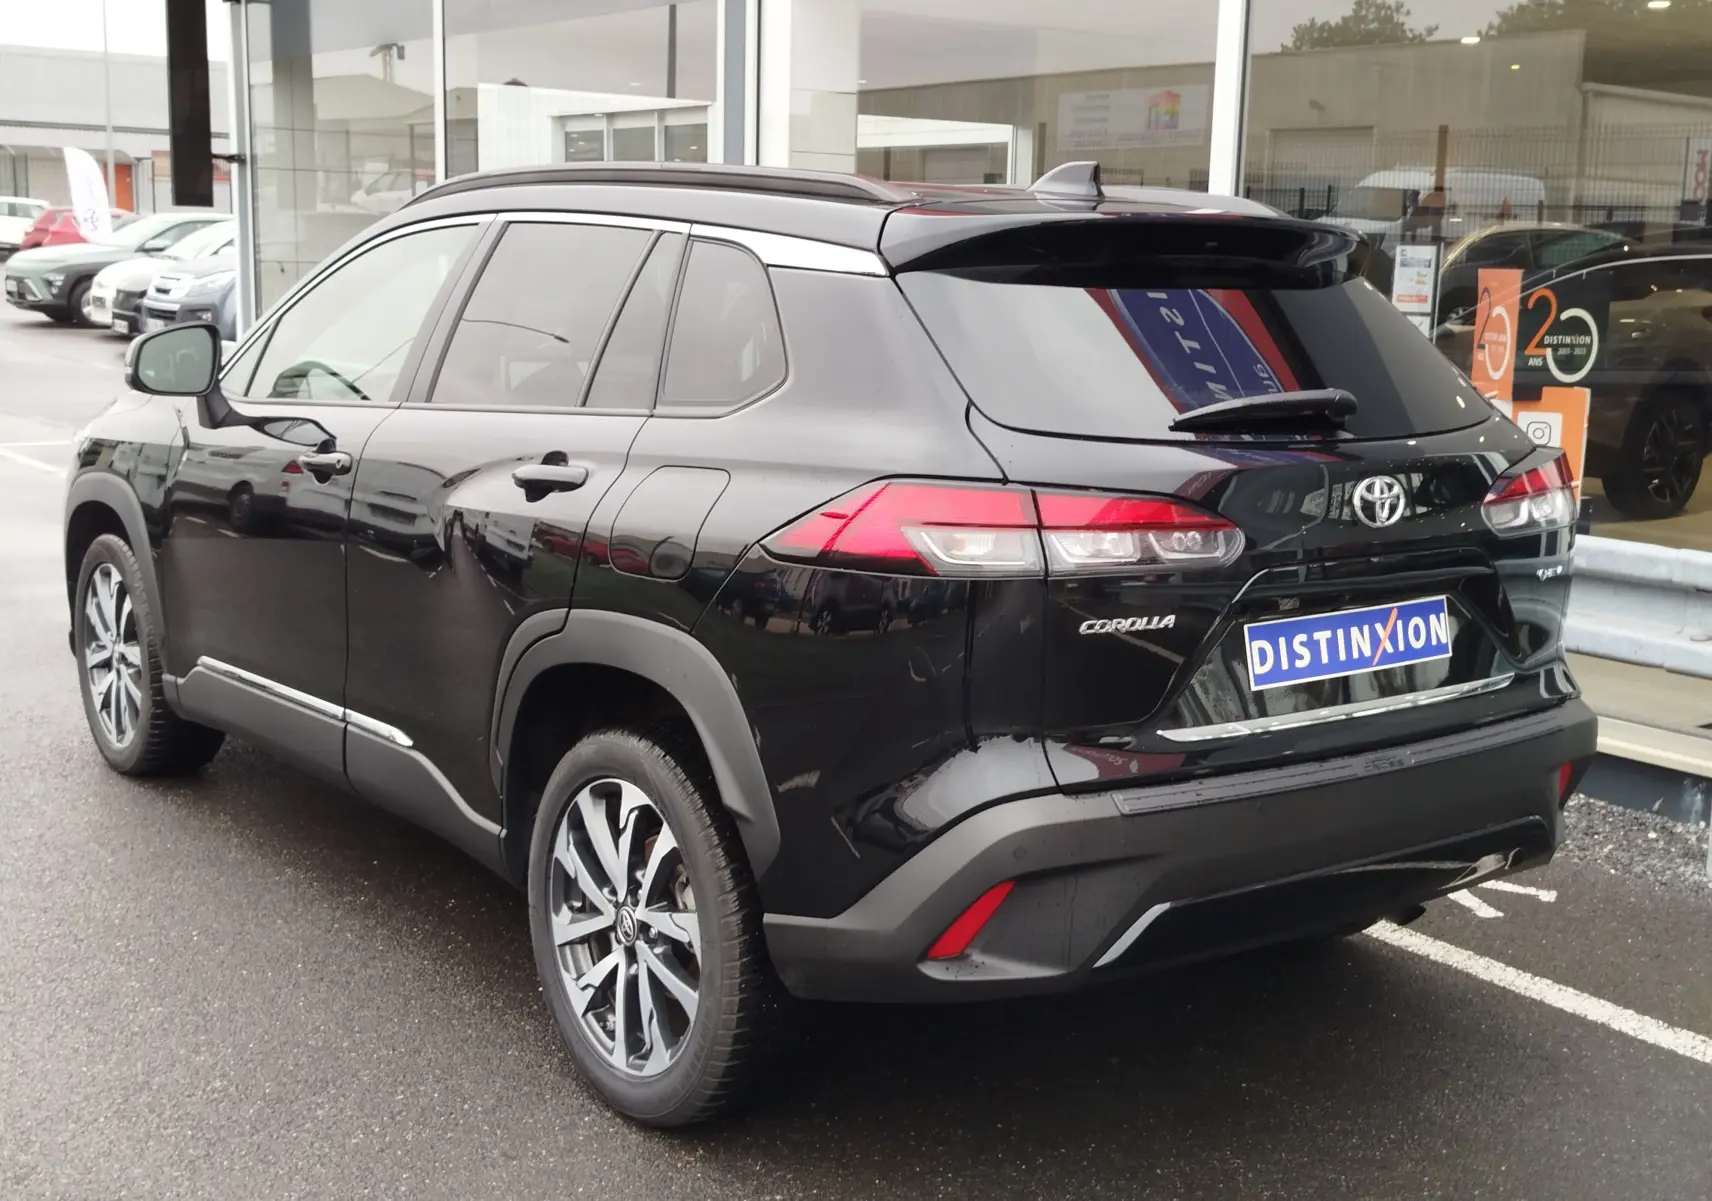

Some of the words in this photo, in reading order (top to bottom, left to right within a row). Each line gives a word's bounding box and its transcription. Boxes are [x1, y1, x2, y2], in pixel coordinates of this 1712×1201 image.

[1524, 287, 1599, 383] 20
[1544, 333, 1592, 345] DISTINXION
[1528, 357, 1543, 366] ANS
[1079, 614, 1176, 635] COROLLA
[1251, 606, 1448, 675] DISTINXION
